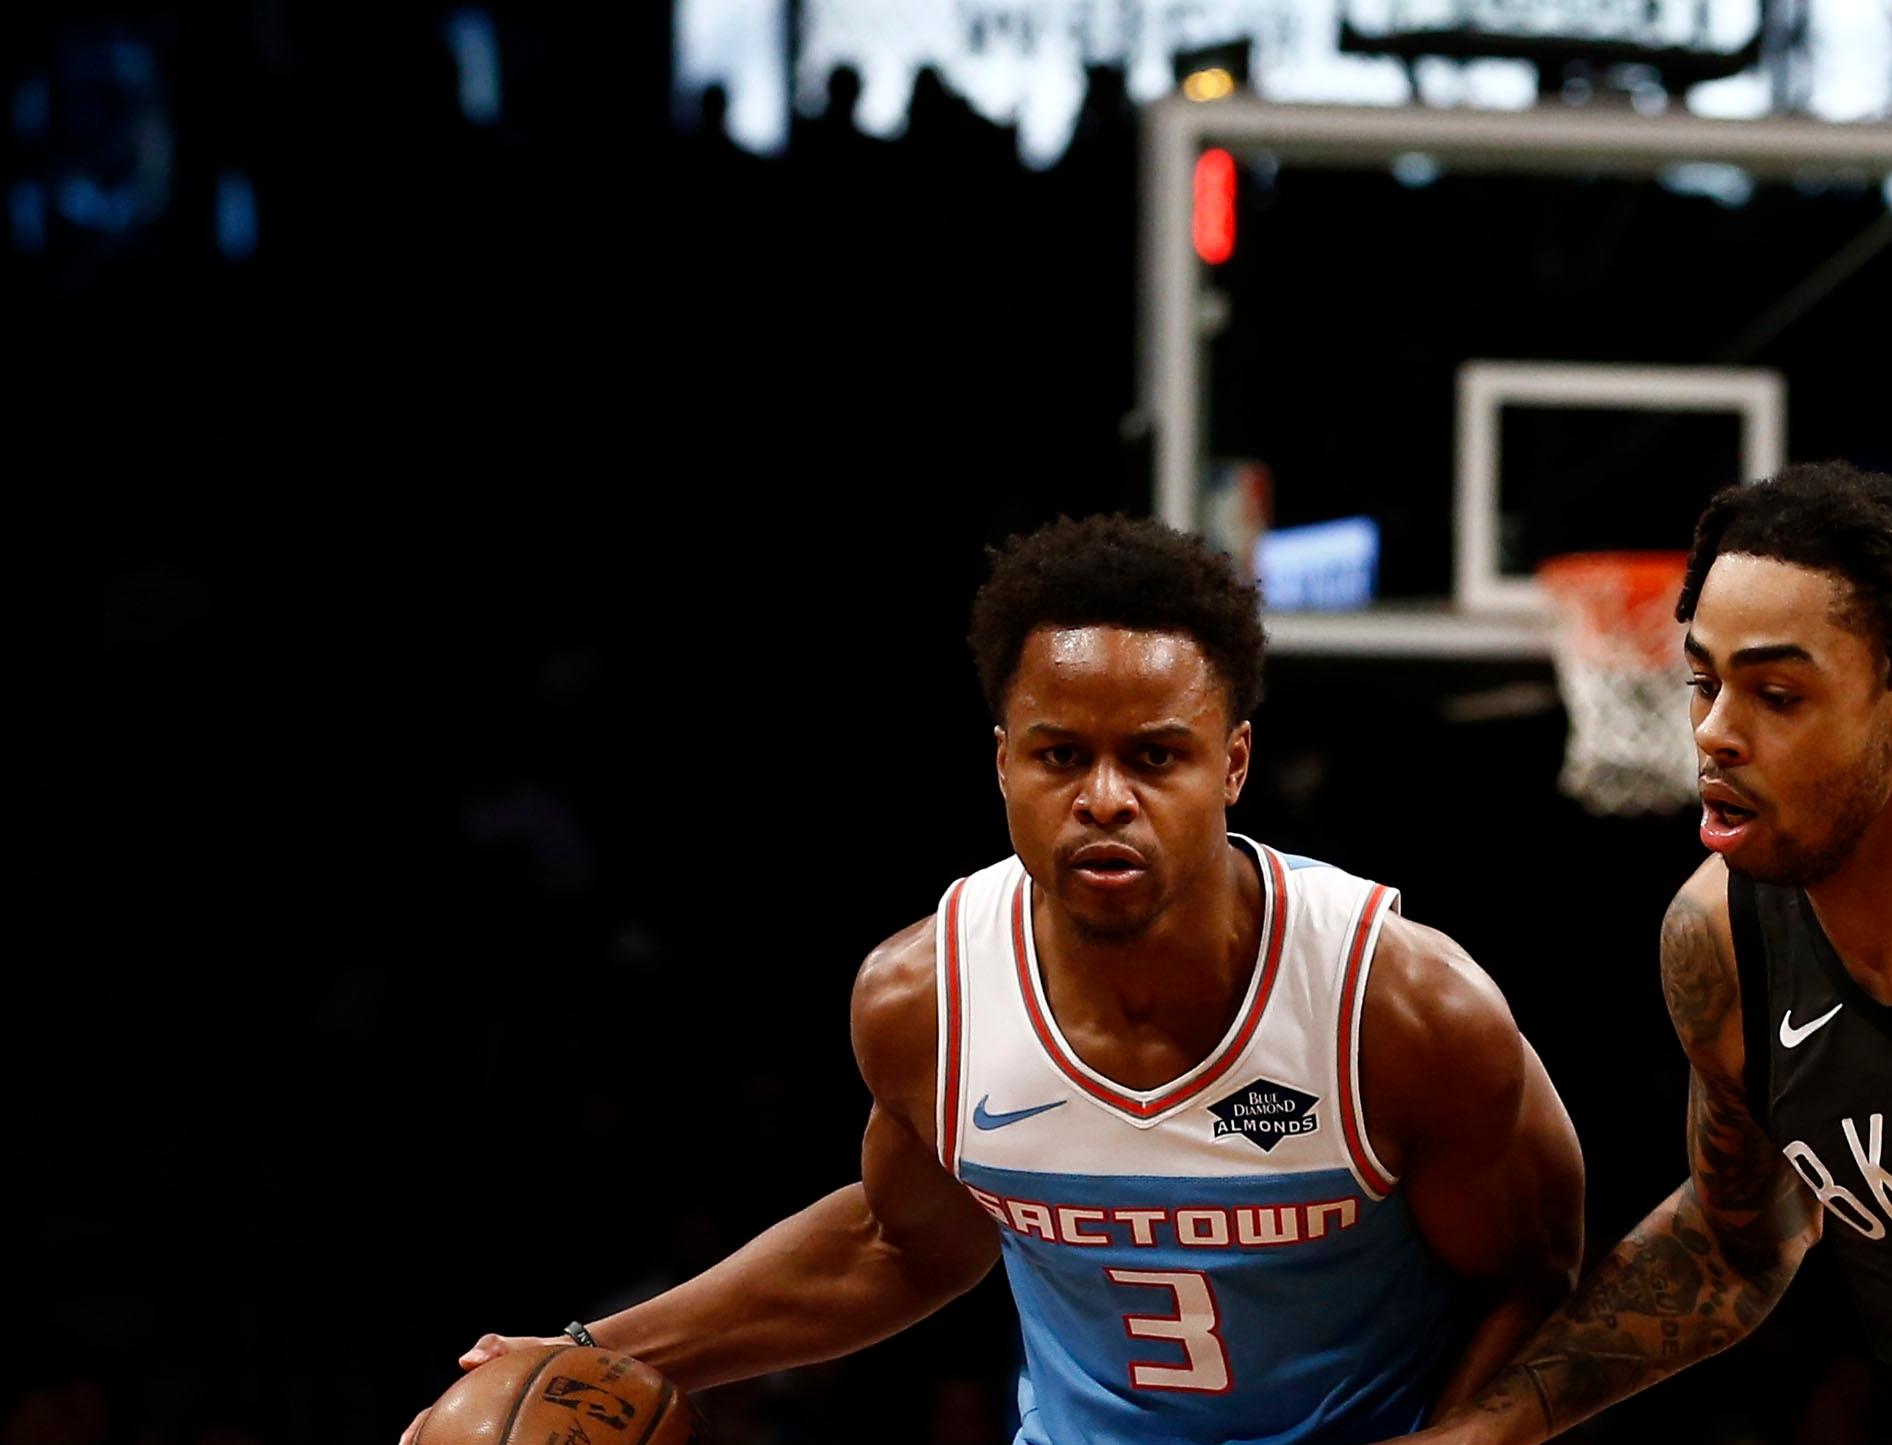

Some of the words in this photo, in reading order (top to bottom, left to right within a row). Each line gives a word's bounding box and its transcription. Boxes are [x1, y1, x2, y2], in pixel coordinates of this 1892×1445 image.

[1233, 1099, 1296, 1117] DIAMOND
[1217, 1117, 1313, 1134] ALMONDS
[1103, 1266, 1233, 1394] 3
